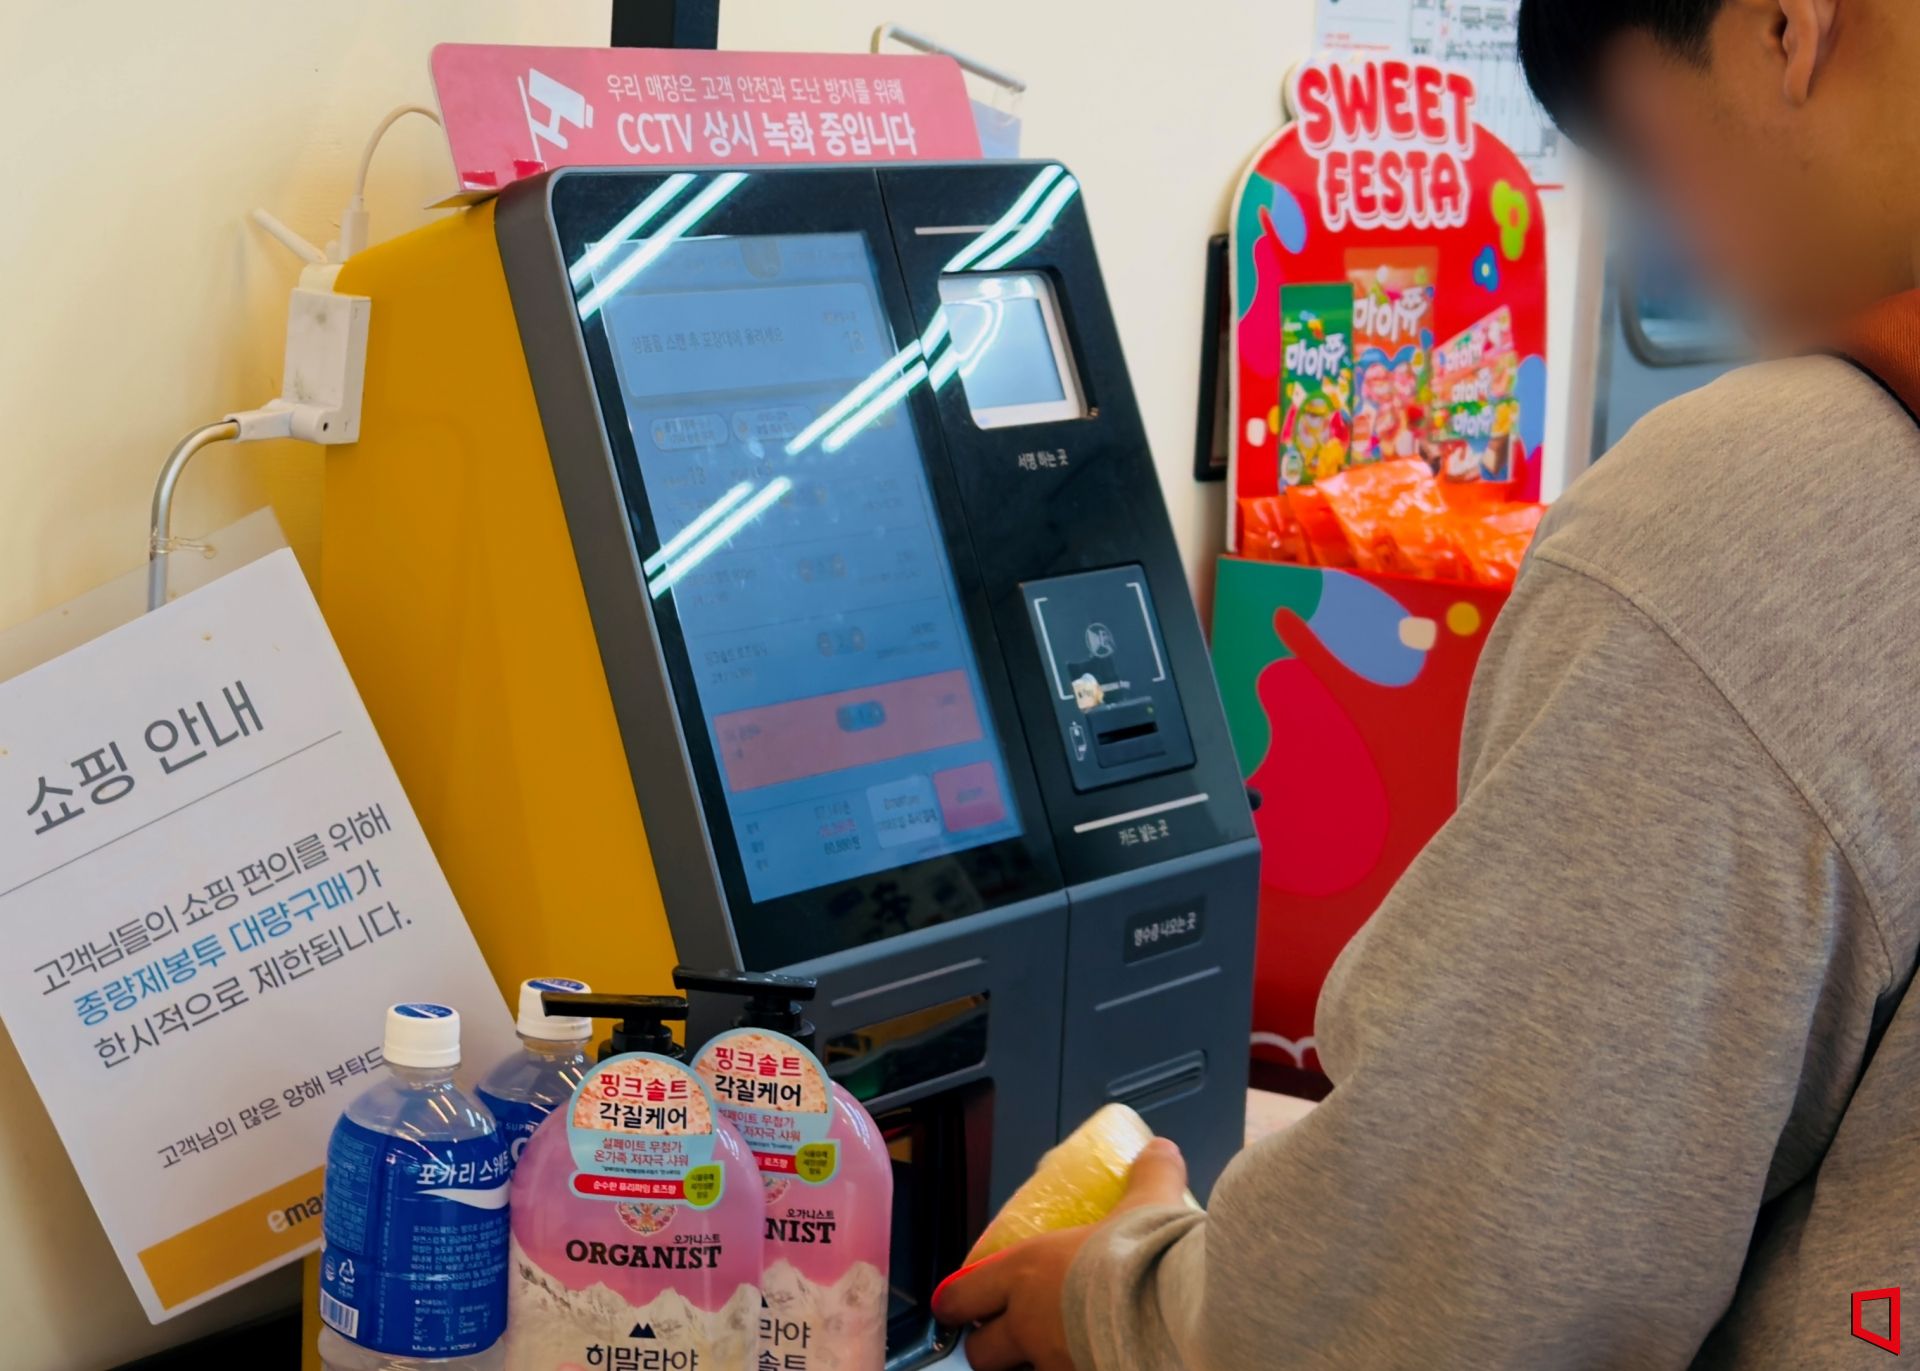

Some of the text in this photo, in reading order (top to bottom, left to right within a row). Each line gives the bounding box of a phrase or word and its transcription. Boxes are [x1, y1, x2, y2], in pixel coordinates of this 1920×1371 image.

[607, 74, 905, 105] 우리 매장은 고객 안전과 도난 방지를 위해
[1299, 60, 1475, 147] SWEET
[617, 110, 918, 157] CCTV 상시 녹화 중입니다
[1324, 149, 1464, 220] FESTA
[26, 680, 264, 835] 쇼핑 안내
[33, 803, 392, 995] 고객님들의 쇼핑 편의를 위해
[74, 859, 383, 1026] 종량제봉투 대량구매가
[94, 901, 413, 1068] 한시적으로 제한됩니다.
[714, 1046, 802, 1078] 핑크솔트
[599, 1073, 689, 1102] 핑크솔트
[714, 1074, 802, 1107] 각질케어
[156, 1046, 386, 1169] 고객님의 많은 양해 부탁드
[599, 1102, 688, 1130] 각질케어
[602, 1137, 647, 1152] 설페이트
[630, 1154, 664, 1166] 저자극
[416, 1161, 476, 1186] 포카리
[267, 1192, 326, 1233] ema
[785, 1208, 835, 1220] 오가니스트
[673, 1234, 721, 1245] 오가니스트
[764, 1217, 836, 1244] NIST
[565, 1239, 722, 1269] ORGANIST
[759, 1318, 811, 1349] 라야
[586, 1344, 699, 1371] 히말라야
[758, 1349, 808, 1371] 솔트
